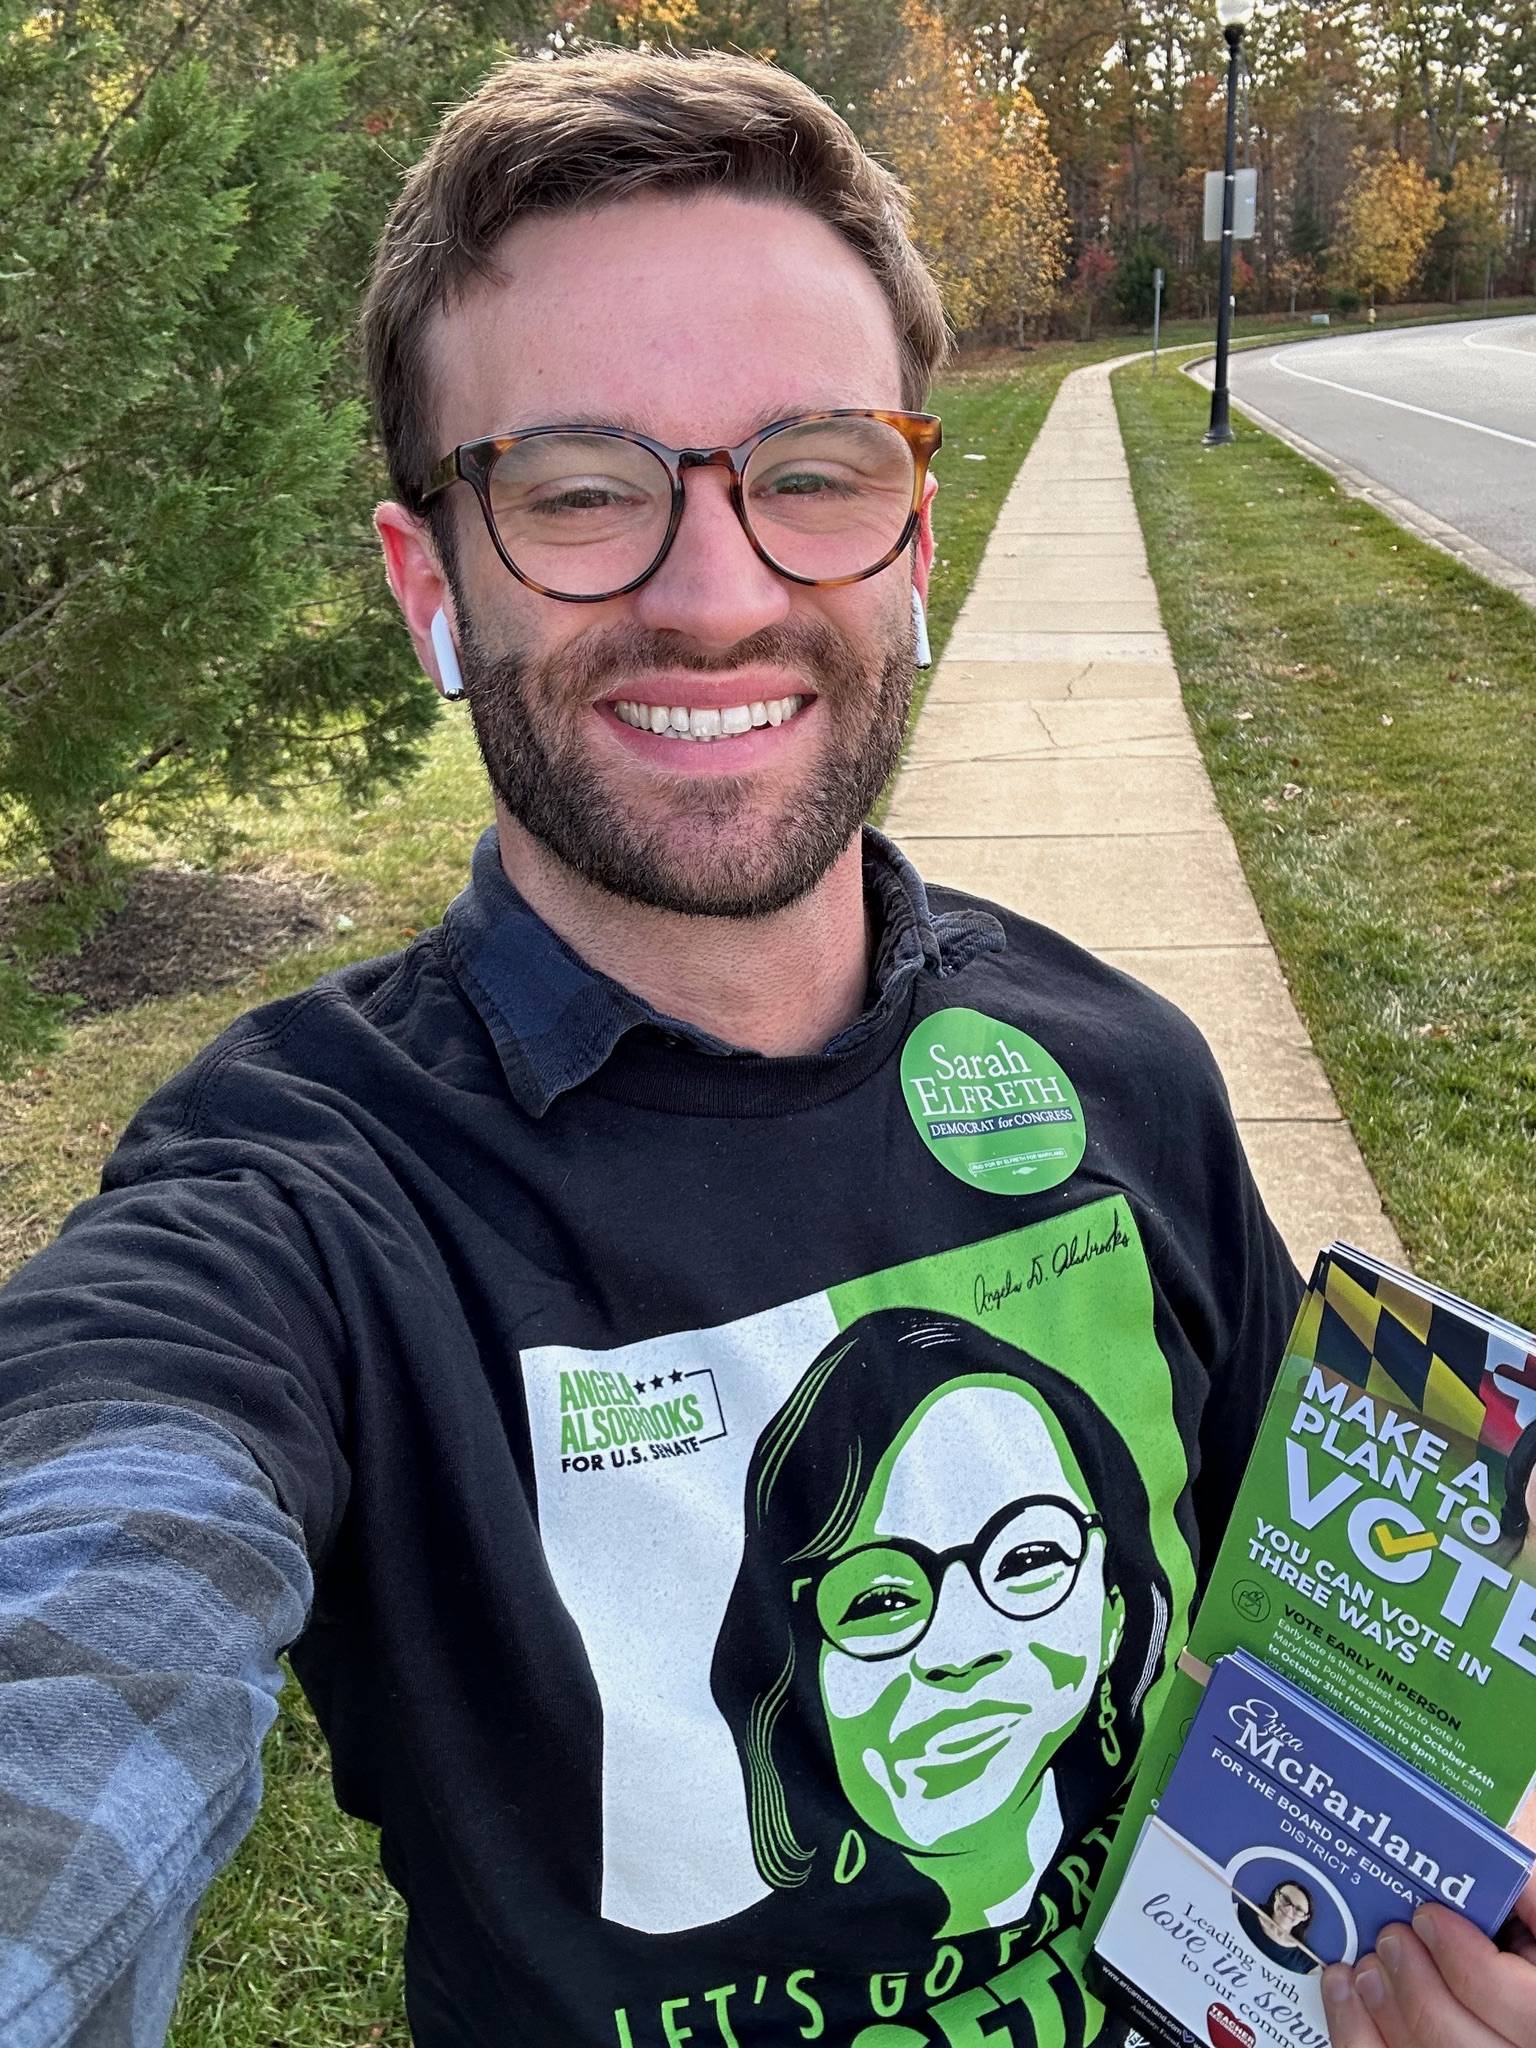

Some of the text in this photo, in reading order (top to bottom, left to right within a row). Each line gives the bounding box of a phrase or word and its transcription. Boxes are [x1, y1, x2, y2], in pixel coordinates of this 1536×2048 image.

[910, 1076, 1067, 1116] ELFRETH
[929, 1040, 1031, 1080] Sarah
[930, 1109, 1073, 1137] DEMOCRAT for CONGRESS
[560, 1368, 640, 1412] ANGELA
[560, 1393, 704, 1455] ALSOBROOKS
[1302, 1366, 1489, 1504] MAKE A
[561, 1436, 701, 1473] FOR U.S. SENATE
[1290, 1401, 1501, 1545] PLAN TO
[1248, 1538, 1418, 1665] THREE WAYS
[1255, 1516, 1492, 1685] YOU CAN VOTE IN
[1285, 1437, 1536, 1676] VOTE
[1278, 1618, 1466, 1752] Early vote is the easiest way to vote in
[1284, 1603, 1461, 1731] VOTE EARLY IN PERSON
[1229, 1699, 1304, 1752] Erica
[1268, 1643, 1482, 1797] to October 31st from 7am to 8pm. You can
[1323, 1665, 1347, 1686] Polls
[1348, 1683, 1365, 1699] are
[1367, 1696, 1393, 1719] open
[1394, 1713, 1421, 1737] from
[1423, 1734, 1468, 1768] October
[1468, 1765, 1495, 1789] 24th
[1212, 1748, 1426, 1908] FOR THE BOARD OF EDUCAT
[1235, 1718, 1476, 1910] McFarland
[1280, 1819, 1361, 1885] DISTRICT 3
[870, 1944, 964, 2018] GO
[1142, 1893, 1207, 1954] love
[1213, 1953, 1249, 1988] in
[1183, 1902, 1302, 2005] Leading with
[1181, 1953, 1295, 2048] to our comm
[1209, 2004, 1255, 2045] TEACHER
